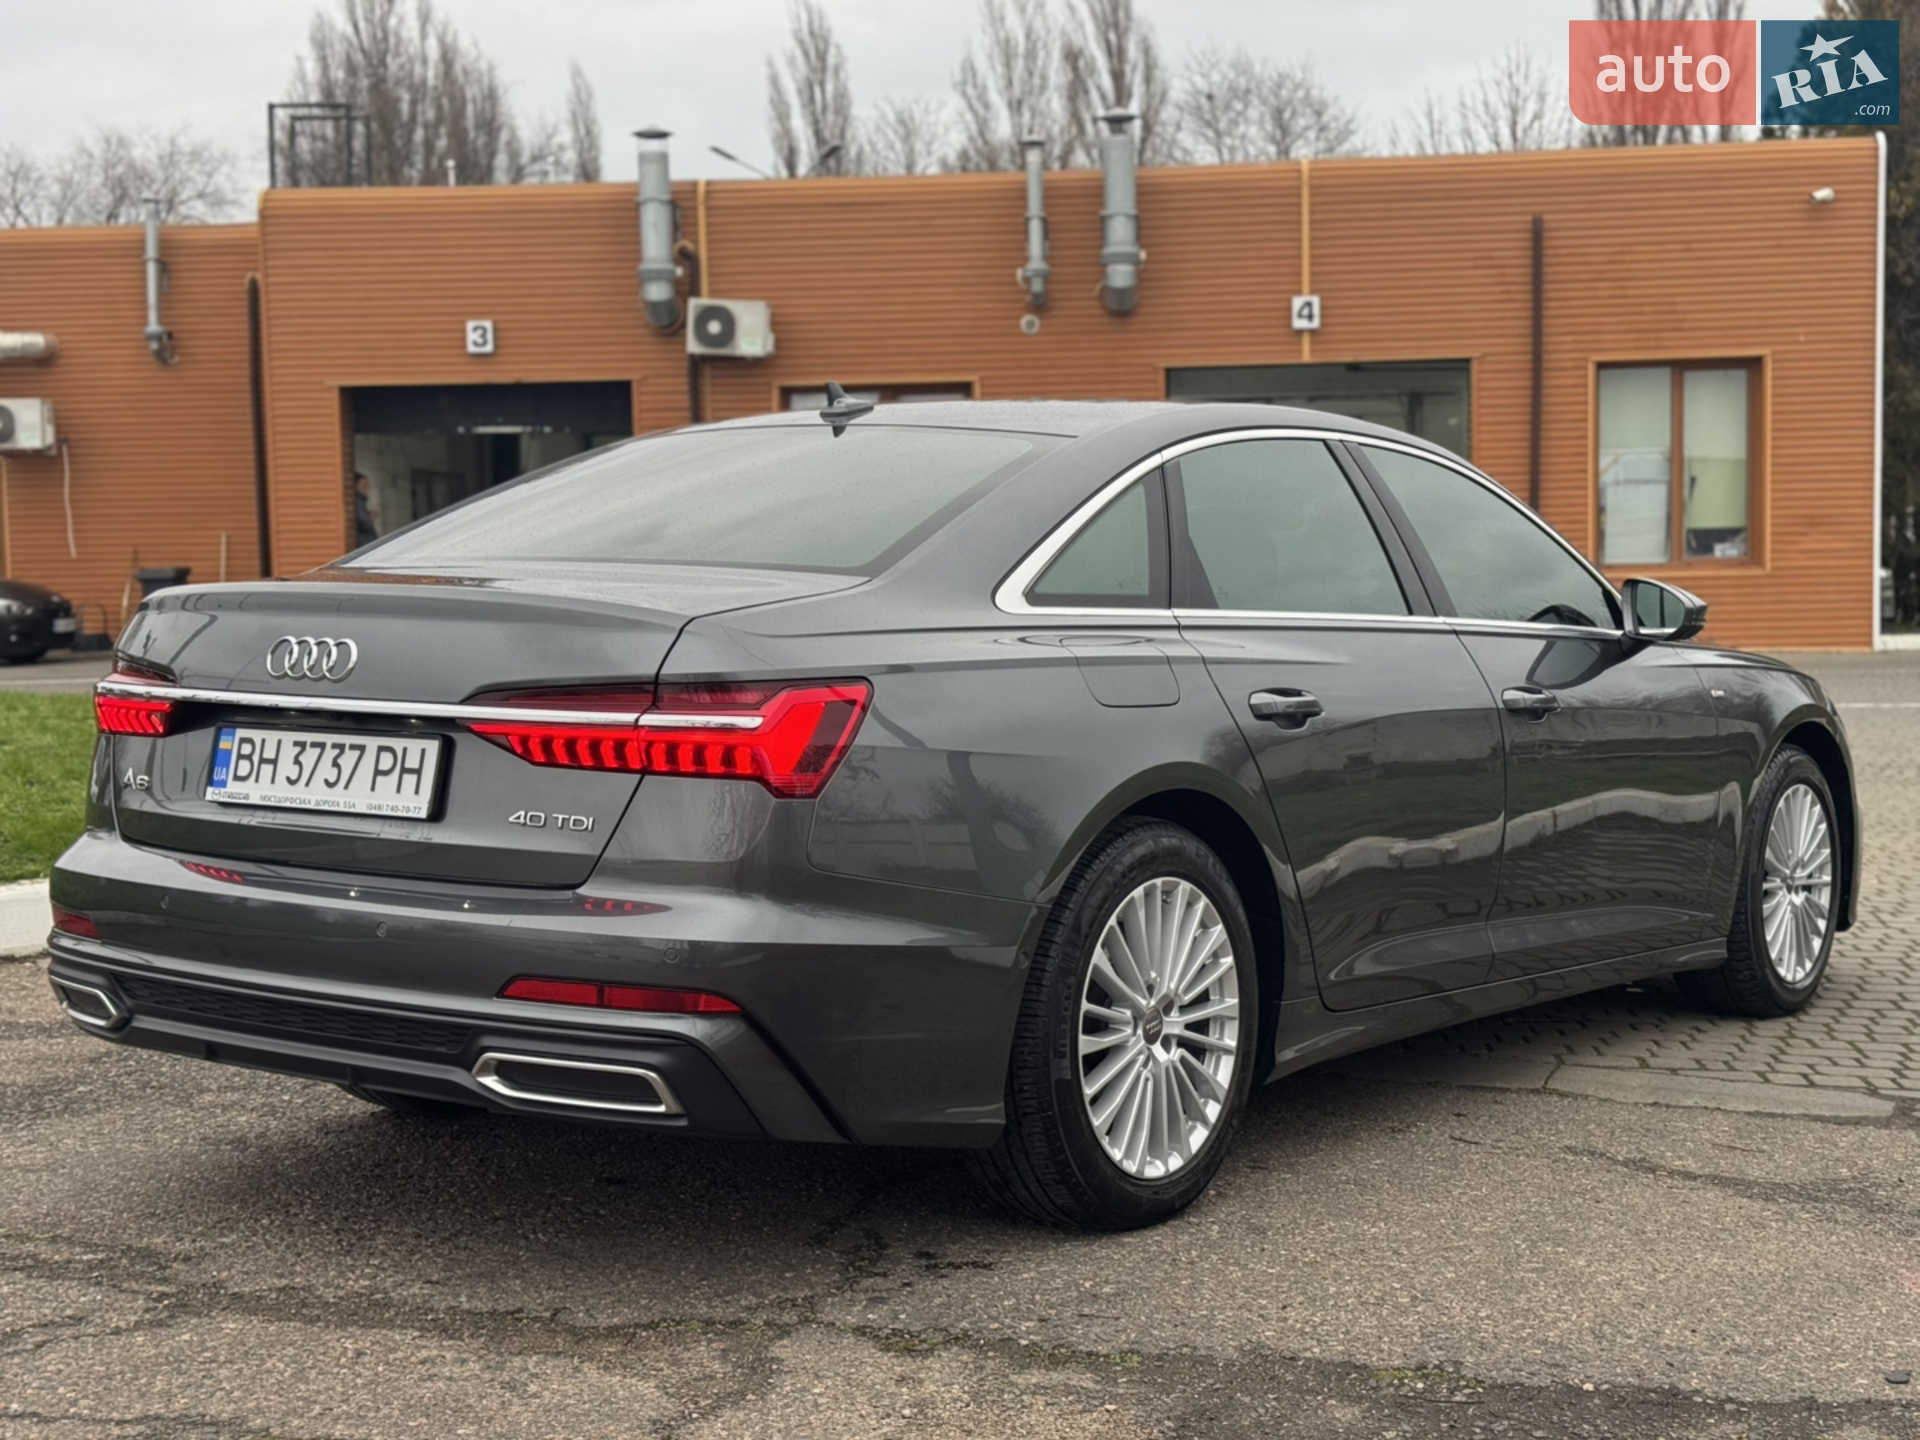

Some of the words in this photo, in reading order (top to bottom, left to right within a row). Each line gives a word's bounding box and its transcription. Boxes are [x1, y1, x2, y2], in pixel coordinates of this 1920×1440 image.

[1297, 300, 1314, 323] 4
[472, 325, 488, 348] 3
[213, 766, 227, 781] UA
[231, 736, 283, 785] BH
[285, 740, 367, 790] 3737
[370, 744, 427, 796] PH
[123, 767, 149, 790] A6
[508, 810, 546, 827] 40
[552, 813, 594, 831] TDI
